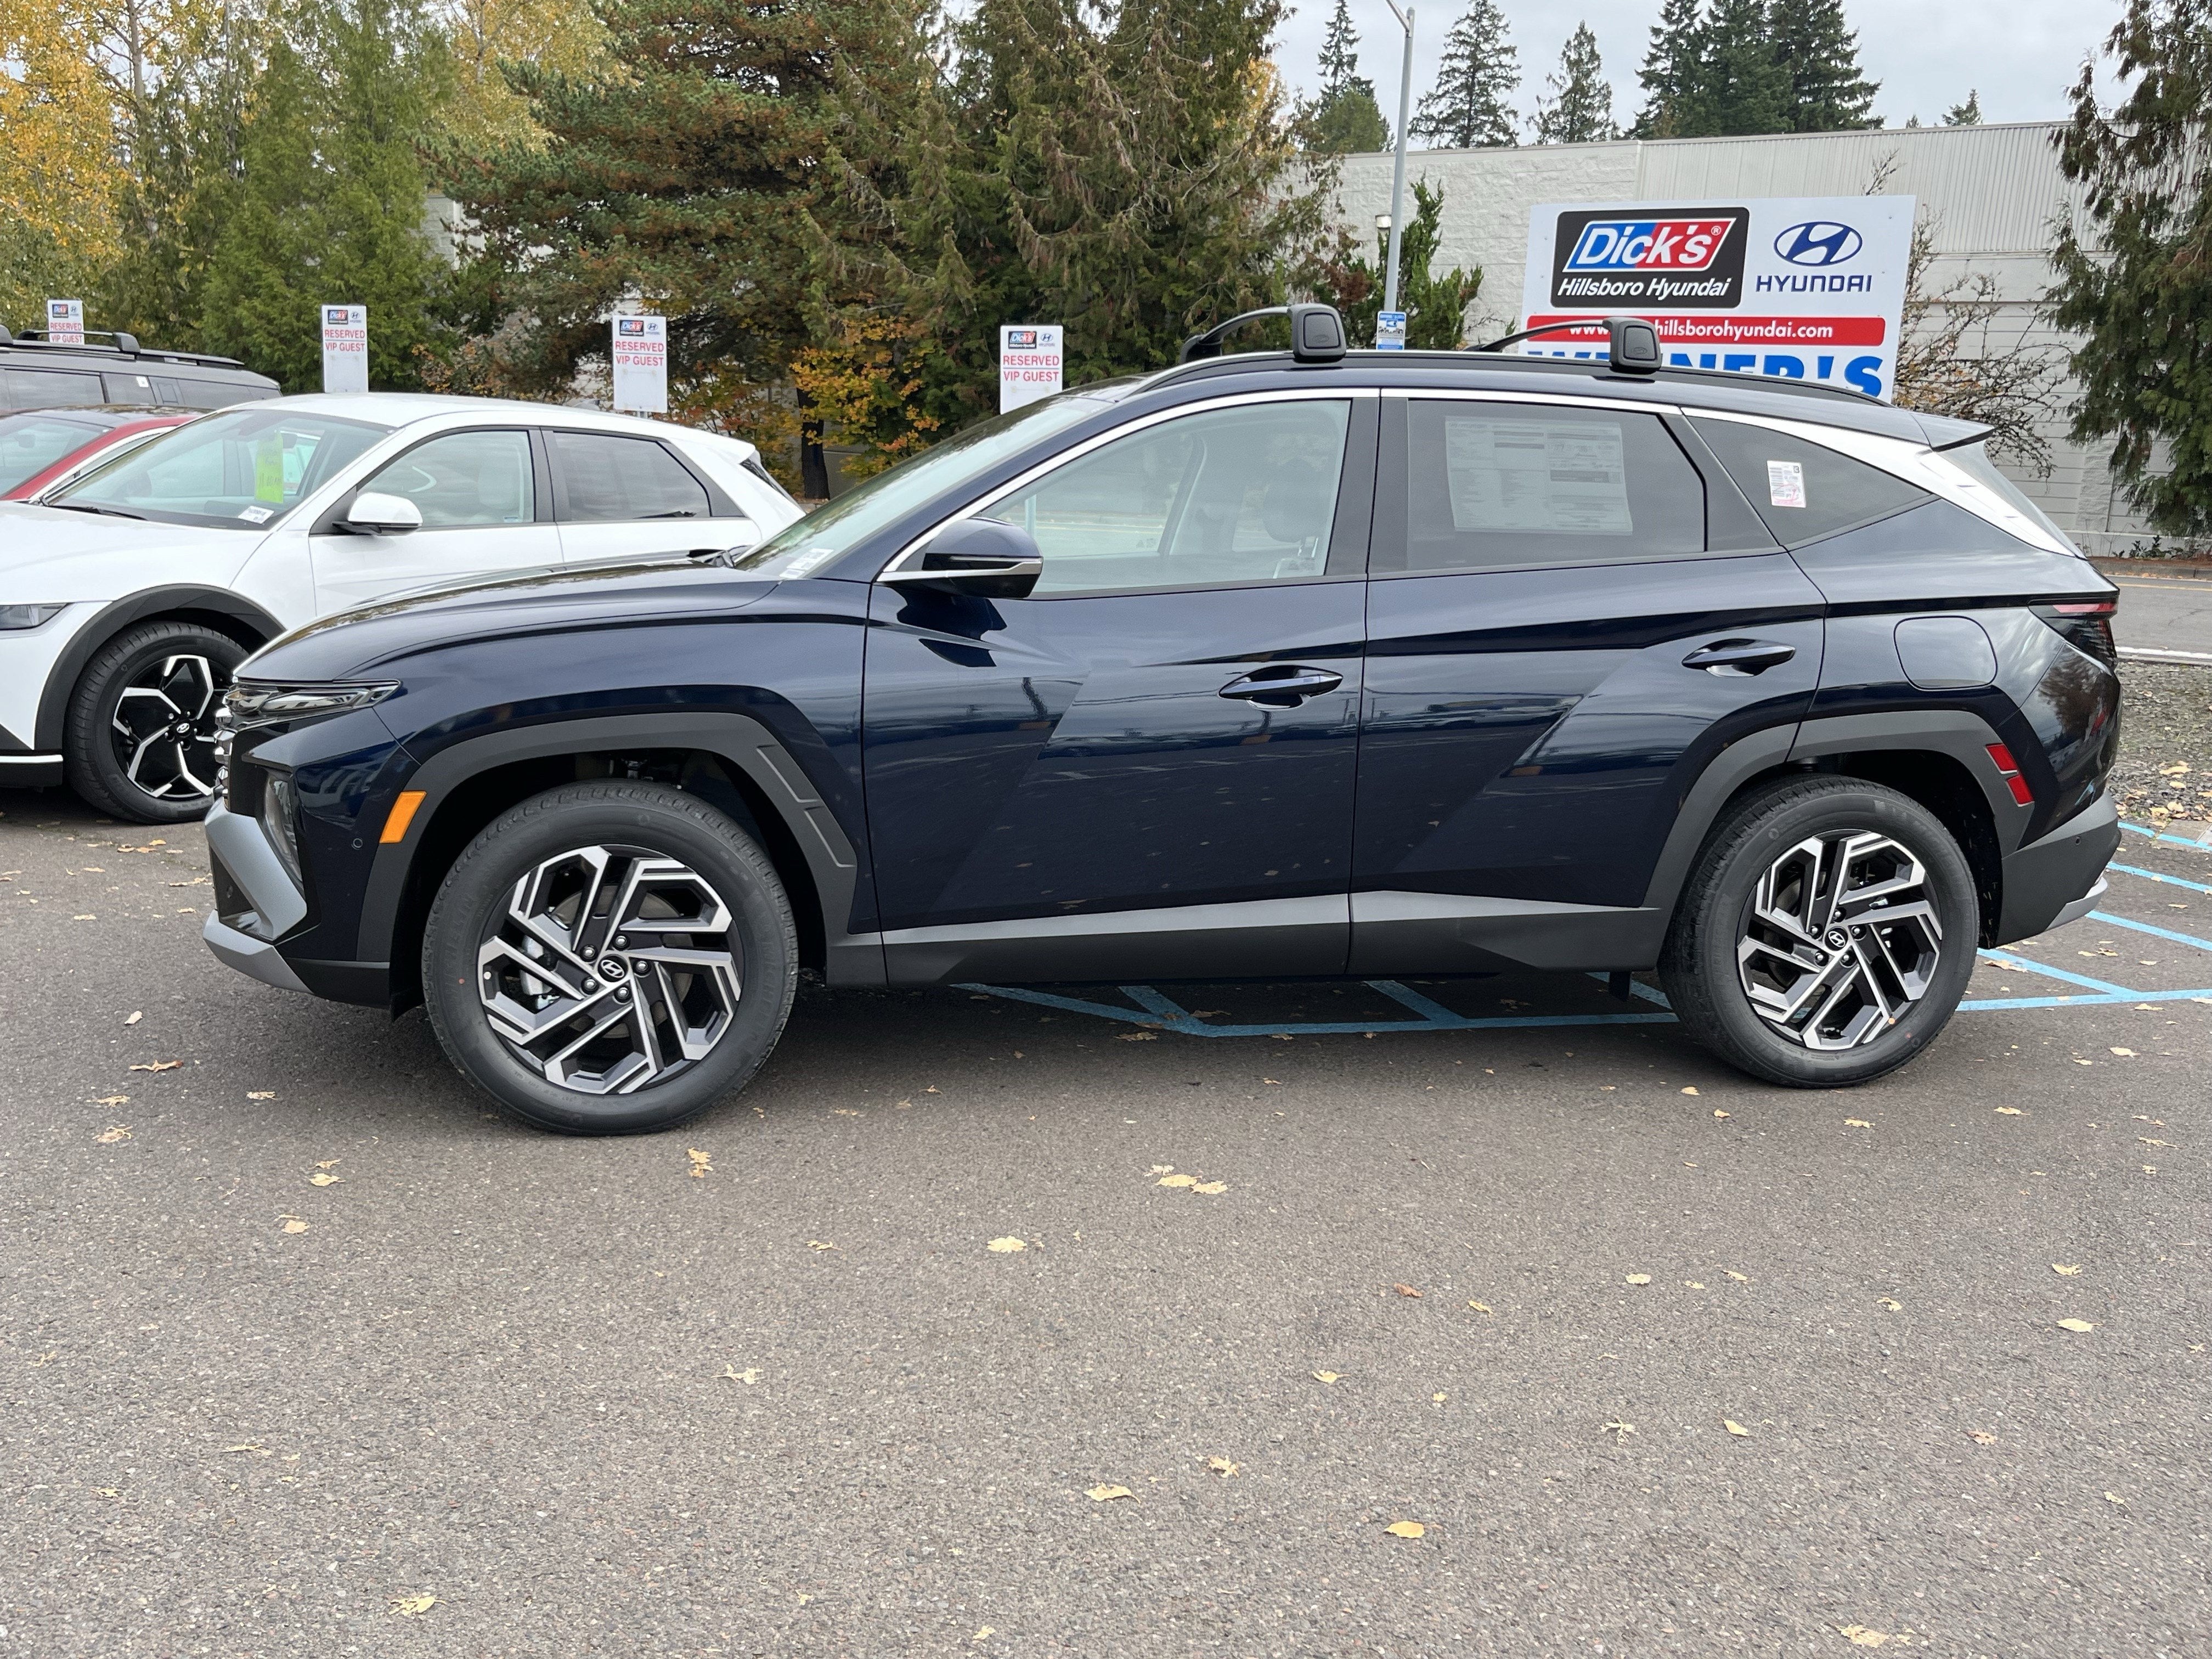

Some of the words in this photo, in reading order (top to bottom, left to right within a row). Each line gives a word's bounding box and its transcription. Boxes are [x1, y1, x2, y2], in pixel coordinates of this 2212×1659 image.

[1576, 224, 1713, 265] Dick's
[1755, 274, 1872, 292] HYUNDAI
[1556, 278, 1644, 296] Hillsboro
[1645, 277, 1732, 301] Hyundai
[50, 322, 82, 331] RESERVED
[1570, 319, 1833, 341] wwwhillsborohyundai.com
[51, 334, 60, 342] VIP
[62, 334, 82, 343] GUEST
[324, 329, 365, 338] RESERVED
[325, 342, 337, 351] VIP
[339, 342, 365, 352] GUEST
[615, 341, 664, 352] RESERVED
[616, 355, 630, 364] VIP
[633, 356, 664, 366] GUEST
[1003, 355, 1059, 365] RESERVED
[1003, 371, 1019, 381] VIP
[1023, 371, 1059, 381] GUEST
